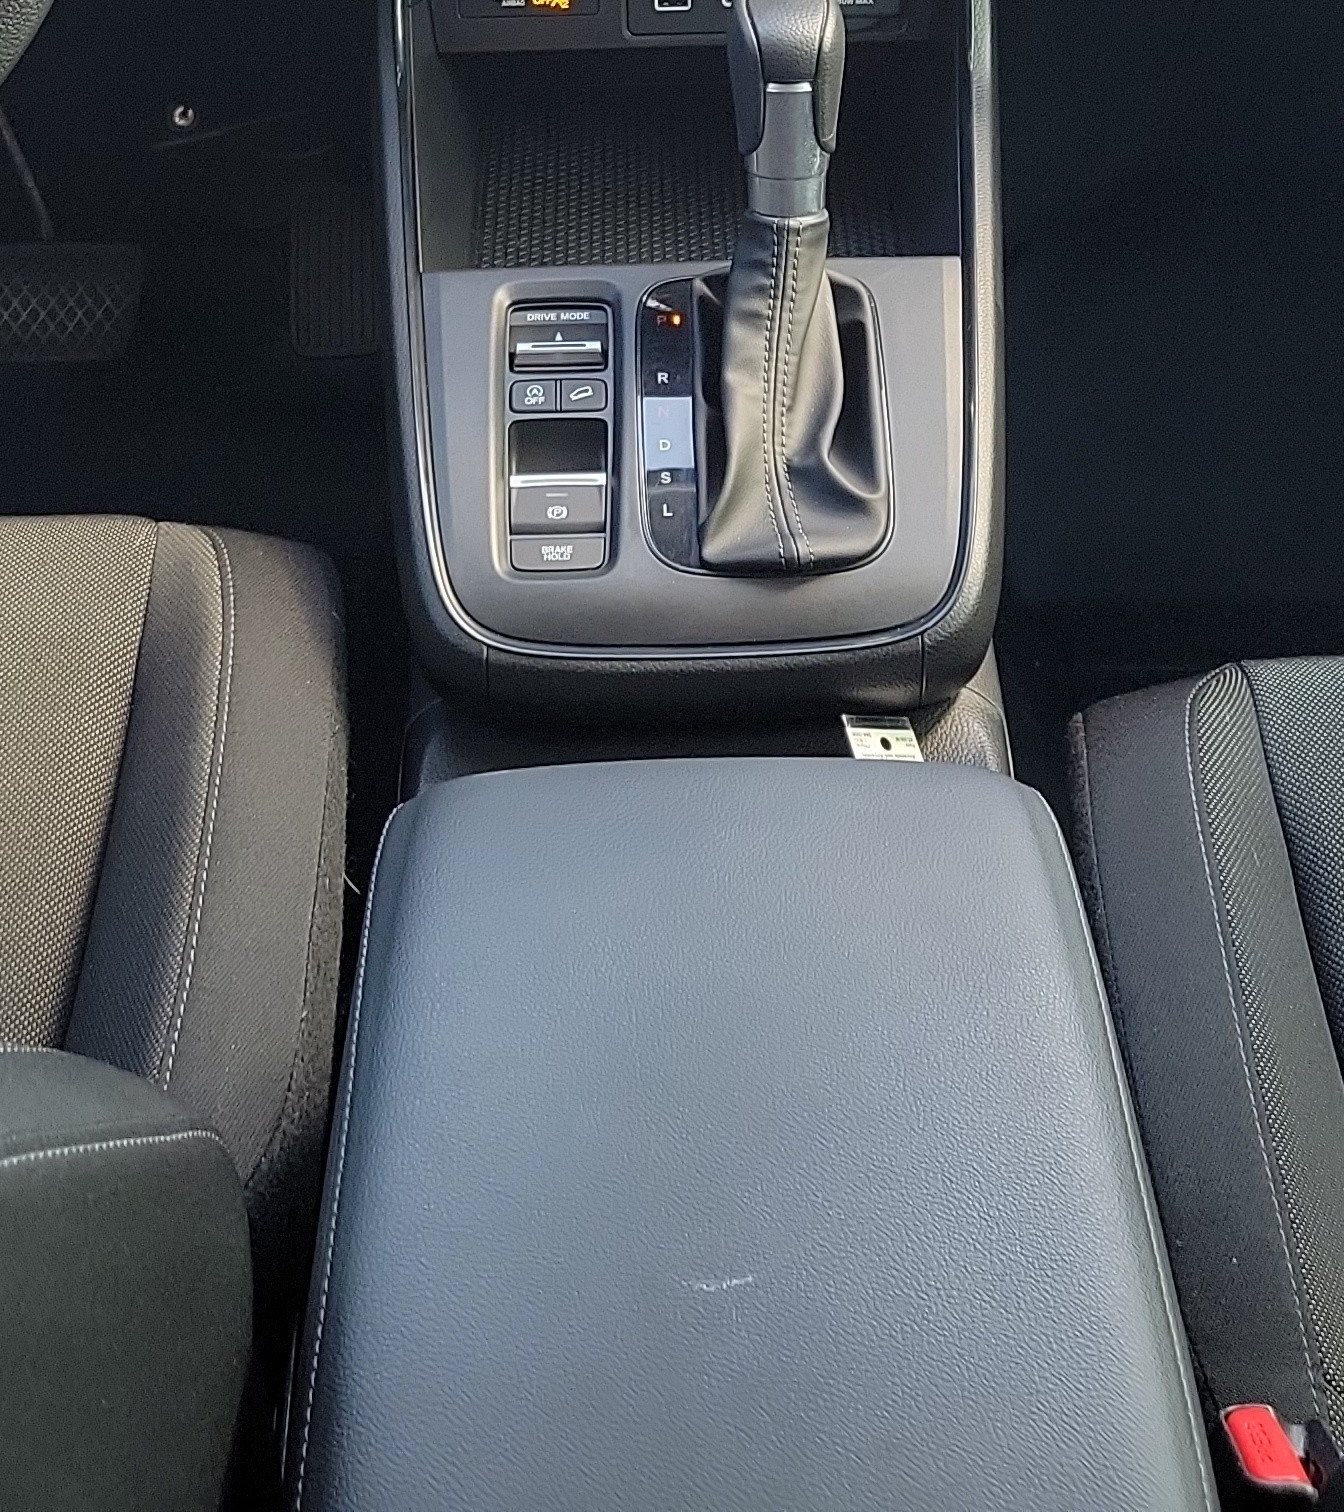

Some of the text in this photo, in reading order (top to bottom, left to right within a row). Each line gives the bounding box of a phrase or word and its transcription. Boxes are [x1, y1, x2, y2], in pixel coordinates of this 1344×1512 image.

[526, 311, 590, 321] DRIVE MODE
[657, 315, 667, 326] P
[657, 372, 669, 385] R
[524, 396, 546, 406] OFF
[659, 407, 668, 417] N
[659, 440, 672, 451] D
[660, 472, 672, 484] S
[662, 503, 673, 517] L
[541, 545, 574, 554] BRAKE
[543, 552, 571, 561] HOLD
